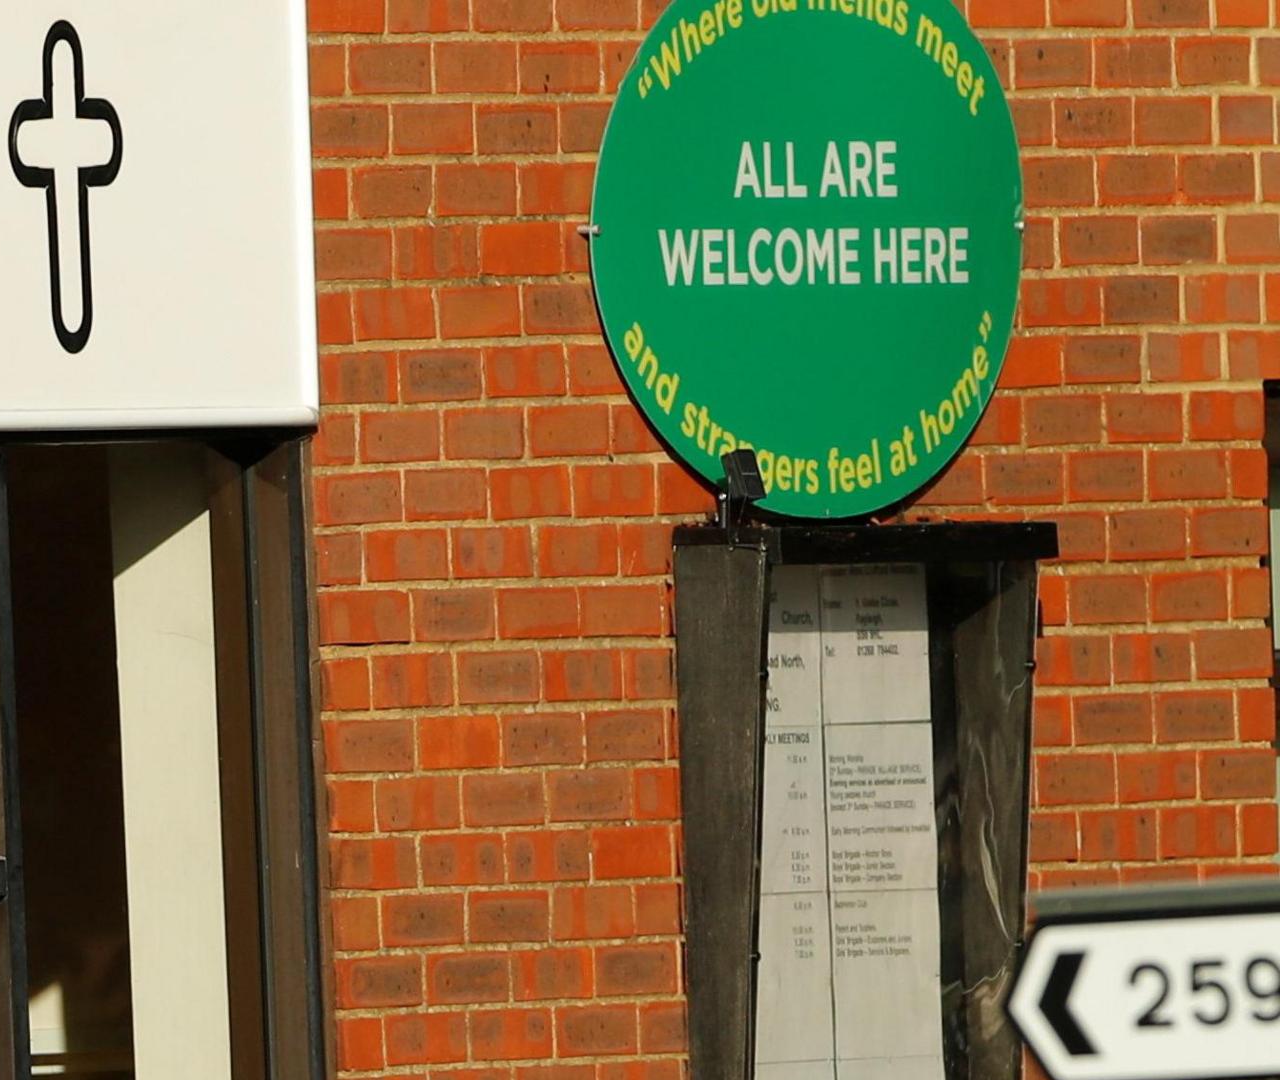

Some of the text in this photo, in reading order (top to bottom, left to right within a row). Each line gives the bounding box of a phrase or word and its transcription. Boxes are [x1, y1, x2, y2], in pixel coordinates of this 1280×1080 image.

[915, 13, 986, 116] meet
[733, 140, 898, 198] ALL ARE
[658, 227, 969, 287] WELCOME HERE
[623, 321, 680, 415] and
[827, 437, 883, 494] feel
[889, 425, 918, 478] at
[781, 610, 814, 626] Church,
[780, 653, 805, 670] North,
[778, 732, 810, 745] MEETINGS
